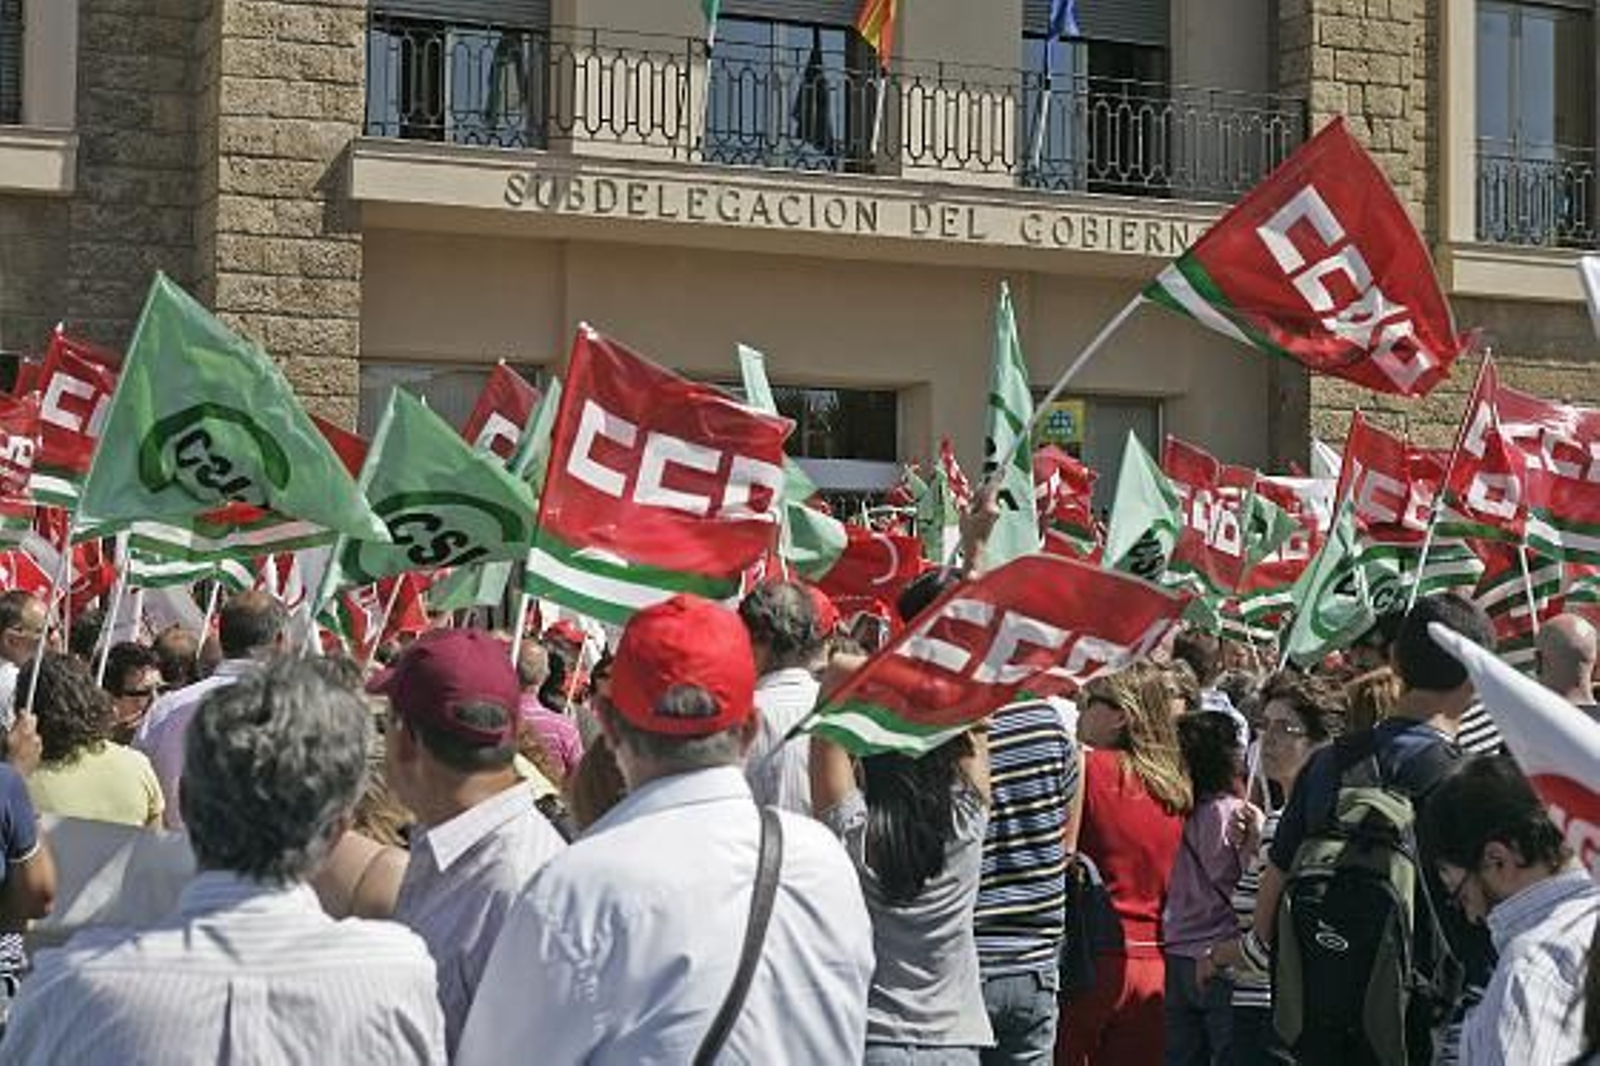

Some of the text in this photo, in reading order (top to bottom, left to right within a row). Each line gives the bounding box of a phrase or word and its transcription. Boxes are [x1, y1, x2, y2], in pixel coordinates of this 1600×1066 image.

[503, 173, 1204, 254] SUBDELEGACION DEL GOBIERN
